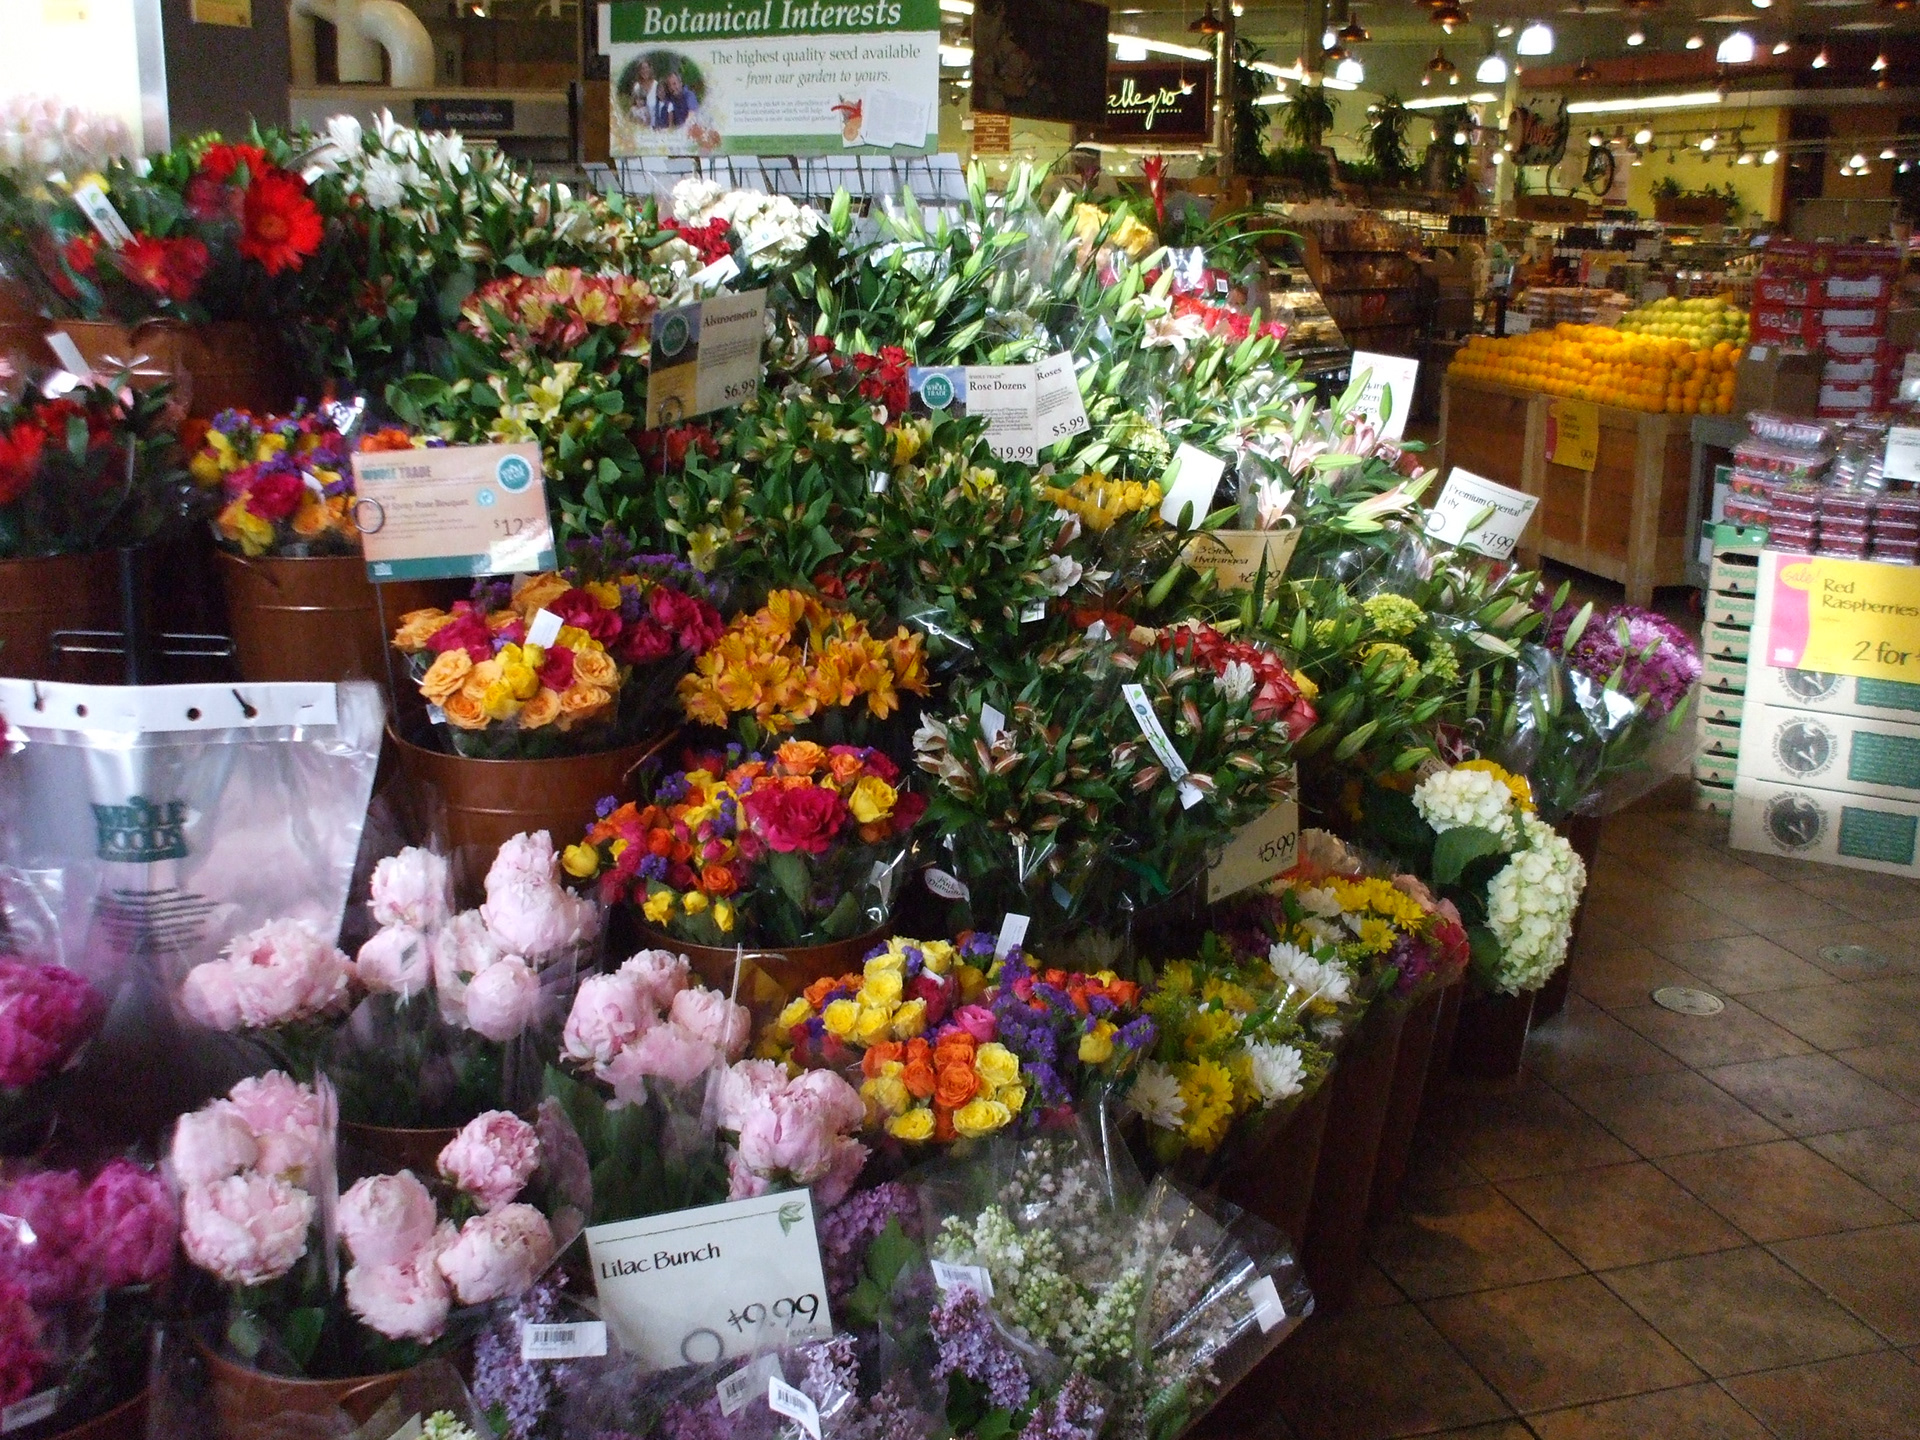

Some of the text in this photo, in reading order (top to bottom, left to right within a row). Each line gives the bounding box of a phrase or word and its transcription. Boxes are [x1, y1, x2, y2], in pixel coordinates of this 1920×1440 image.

[643, 0, 901, 35] Botanical Interests
[711, 45, 921, 69] The highest quality seed available
[746, 70, 891, 87] from our garden to yours.
[1036, 367, 1062, 380] Roses
[724, 379, 756, 399] $6.99
[969, 380, 1027, 391] Rose Dozens
[1052, 416, 1084, 437] $5.99
[991, 446, 1033, 459] $19.99
[1448, 484, 1487, 507] Premium
[1481, 531, 1514, 551] $7.99
[1824, 578, 1855, 593] Red
[1822, 594, 1919, 617] Raspberries
[1852, 640, 1871, 661] 2
[1875, 641, 1912, 665] for
[1257, 832, 1295, 863] $5.99
[601, 1243, 720, 1279] Lilac Bunch
[727, 1293, 819, 1333] $9.99
[791, 1327, 817, 1337] EACH
